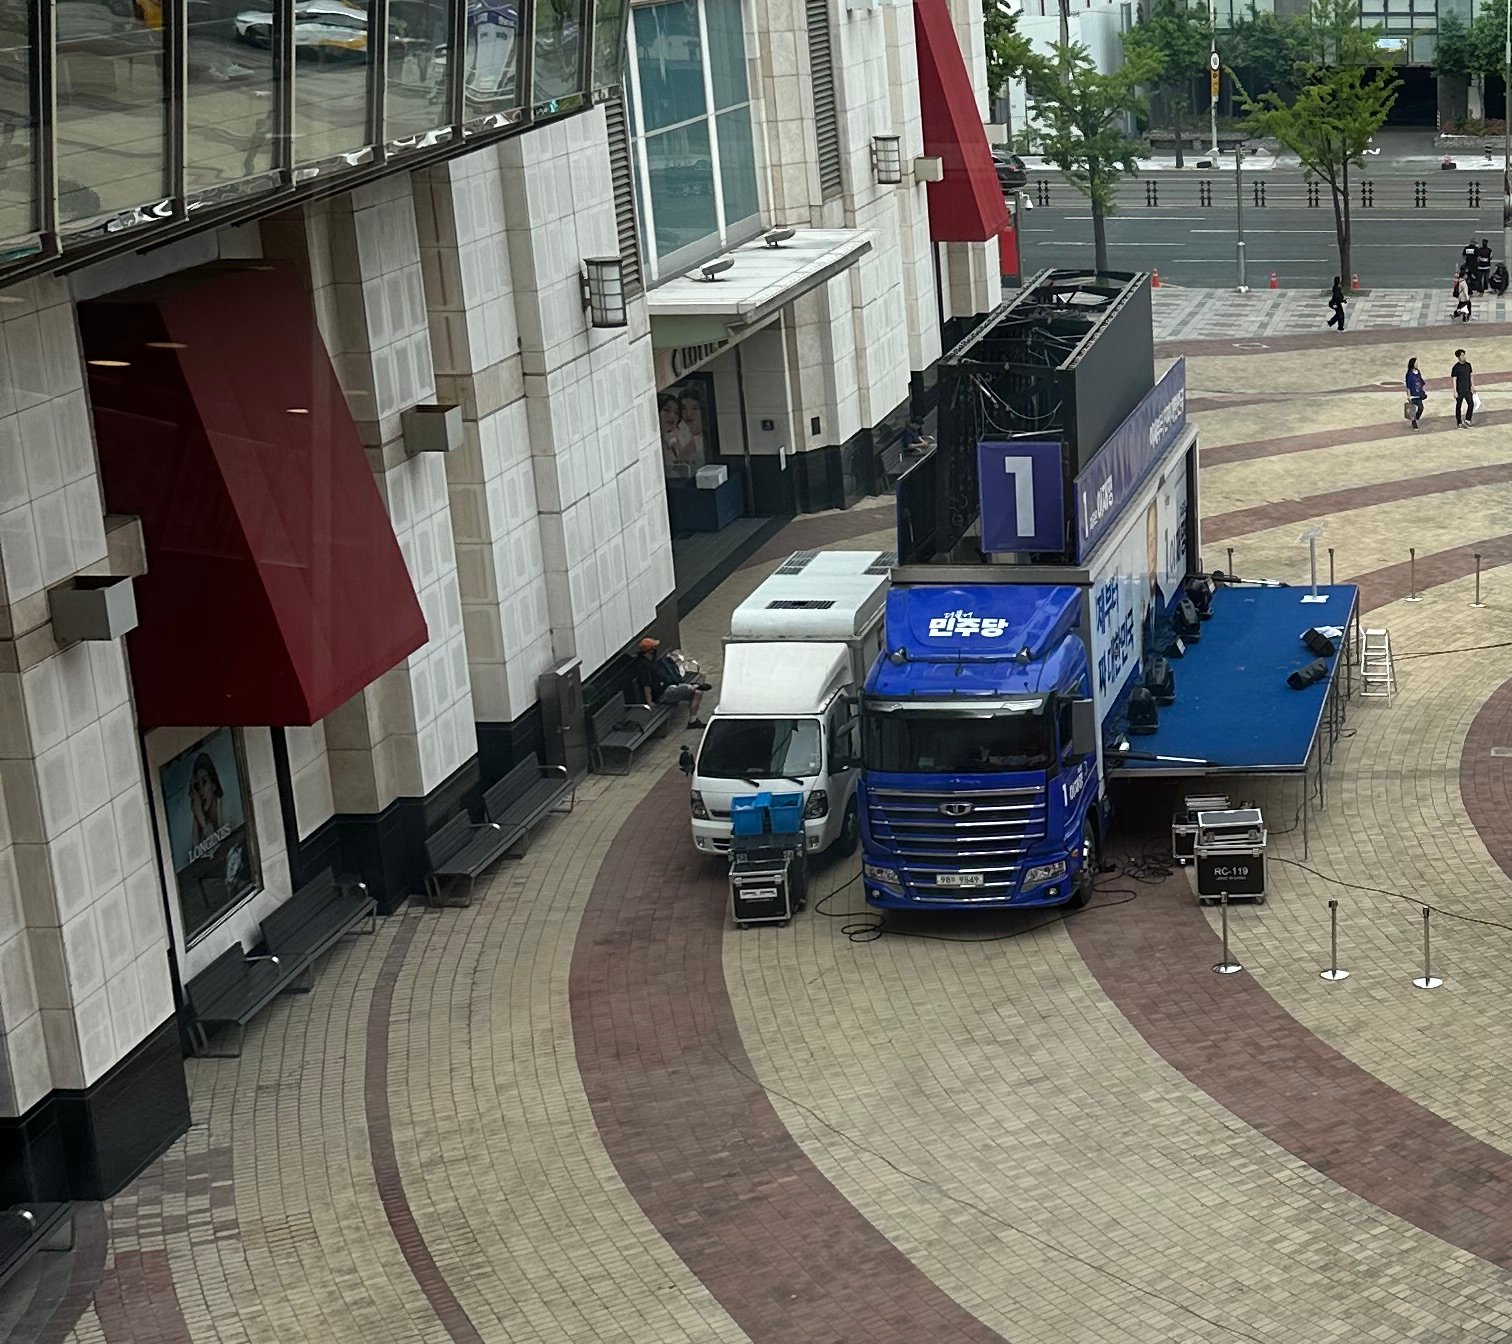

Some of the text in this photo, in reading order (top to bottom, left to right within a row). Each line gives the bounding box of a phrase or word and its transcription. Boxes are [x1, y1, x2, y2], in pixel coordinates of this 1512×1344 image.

[1005, 456, 1035, 537] 1
[928, 618, 1009, 637] 민주당
[188, 823, 231, 864] LONGINES
